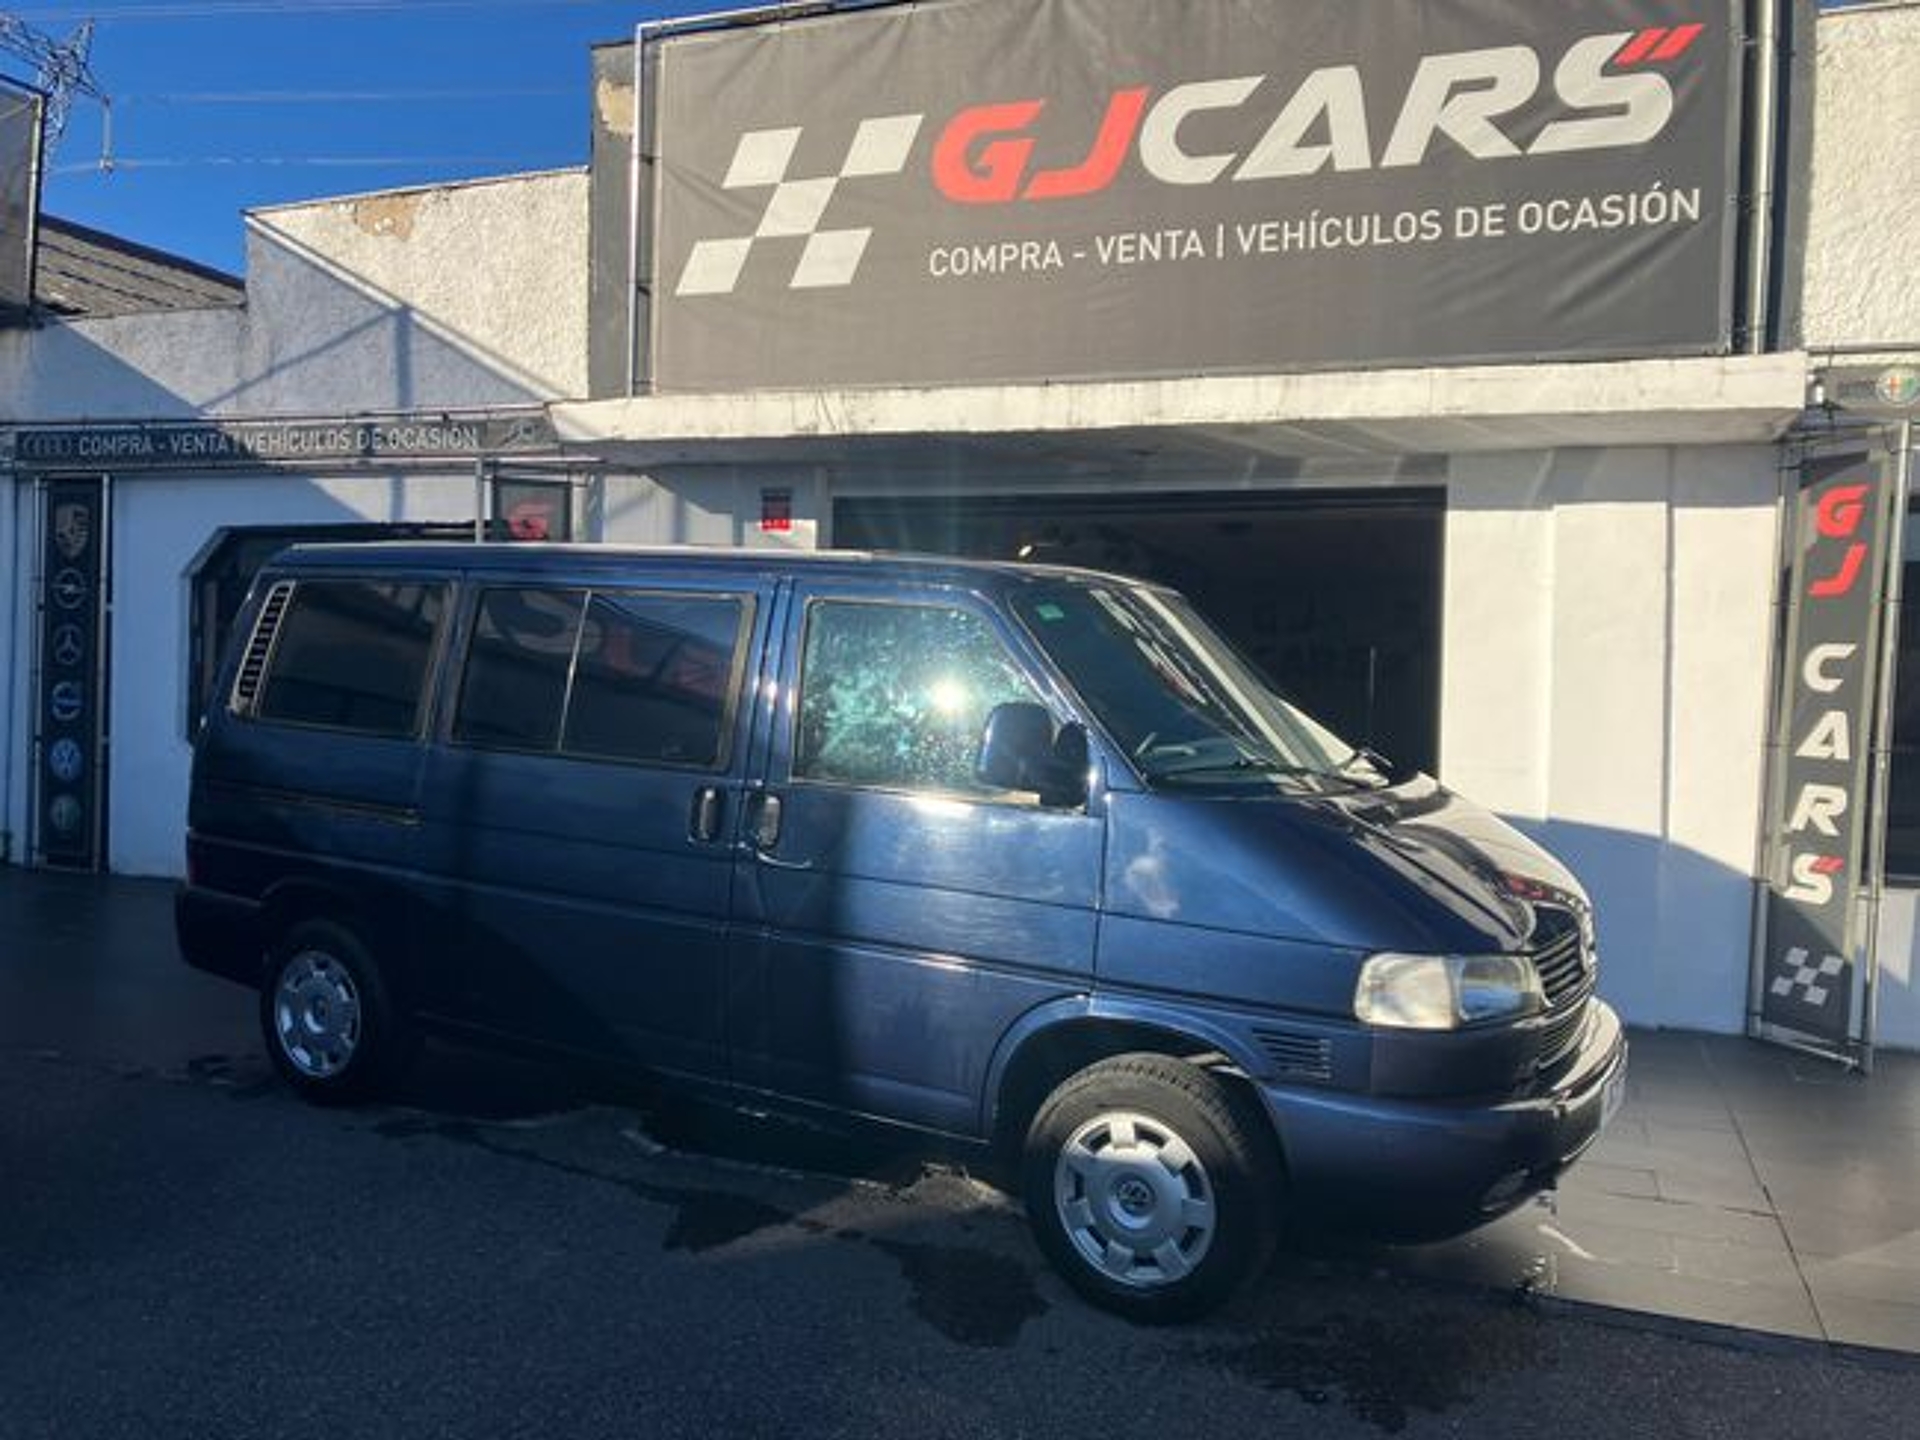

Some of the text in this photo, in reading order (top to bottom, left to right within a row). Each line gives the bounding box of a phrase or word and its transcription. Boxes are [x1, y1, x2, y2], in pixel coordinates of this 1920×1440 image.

[931, 23, 1704, 202] GJCARS
[929, 239, 1063, 276] COMPRA
[1096, 229, 1204, 264] VENTA
[1237, 206, 1442, 254] VEHÍCULOS
[1455, 203, 1505, 237] DE
[1517, 182, 1700, 235] OCASIÓN
[78, 434, 152, 456] COMPRA
[171, 433, 228, 453] VENTA
[244, 427, 350, 453] VEHÍCULOS
[356, 430, 382, 450] DE
